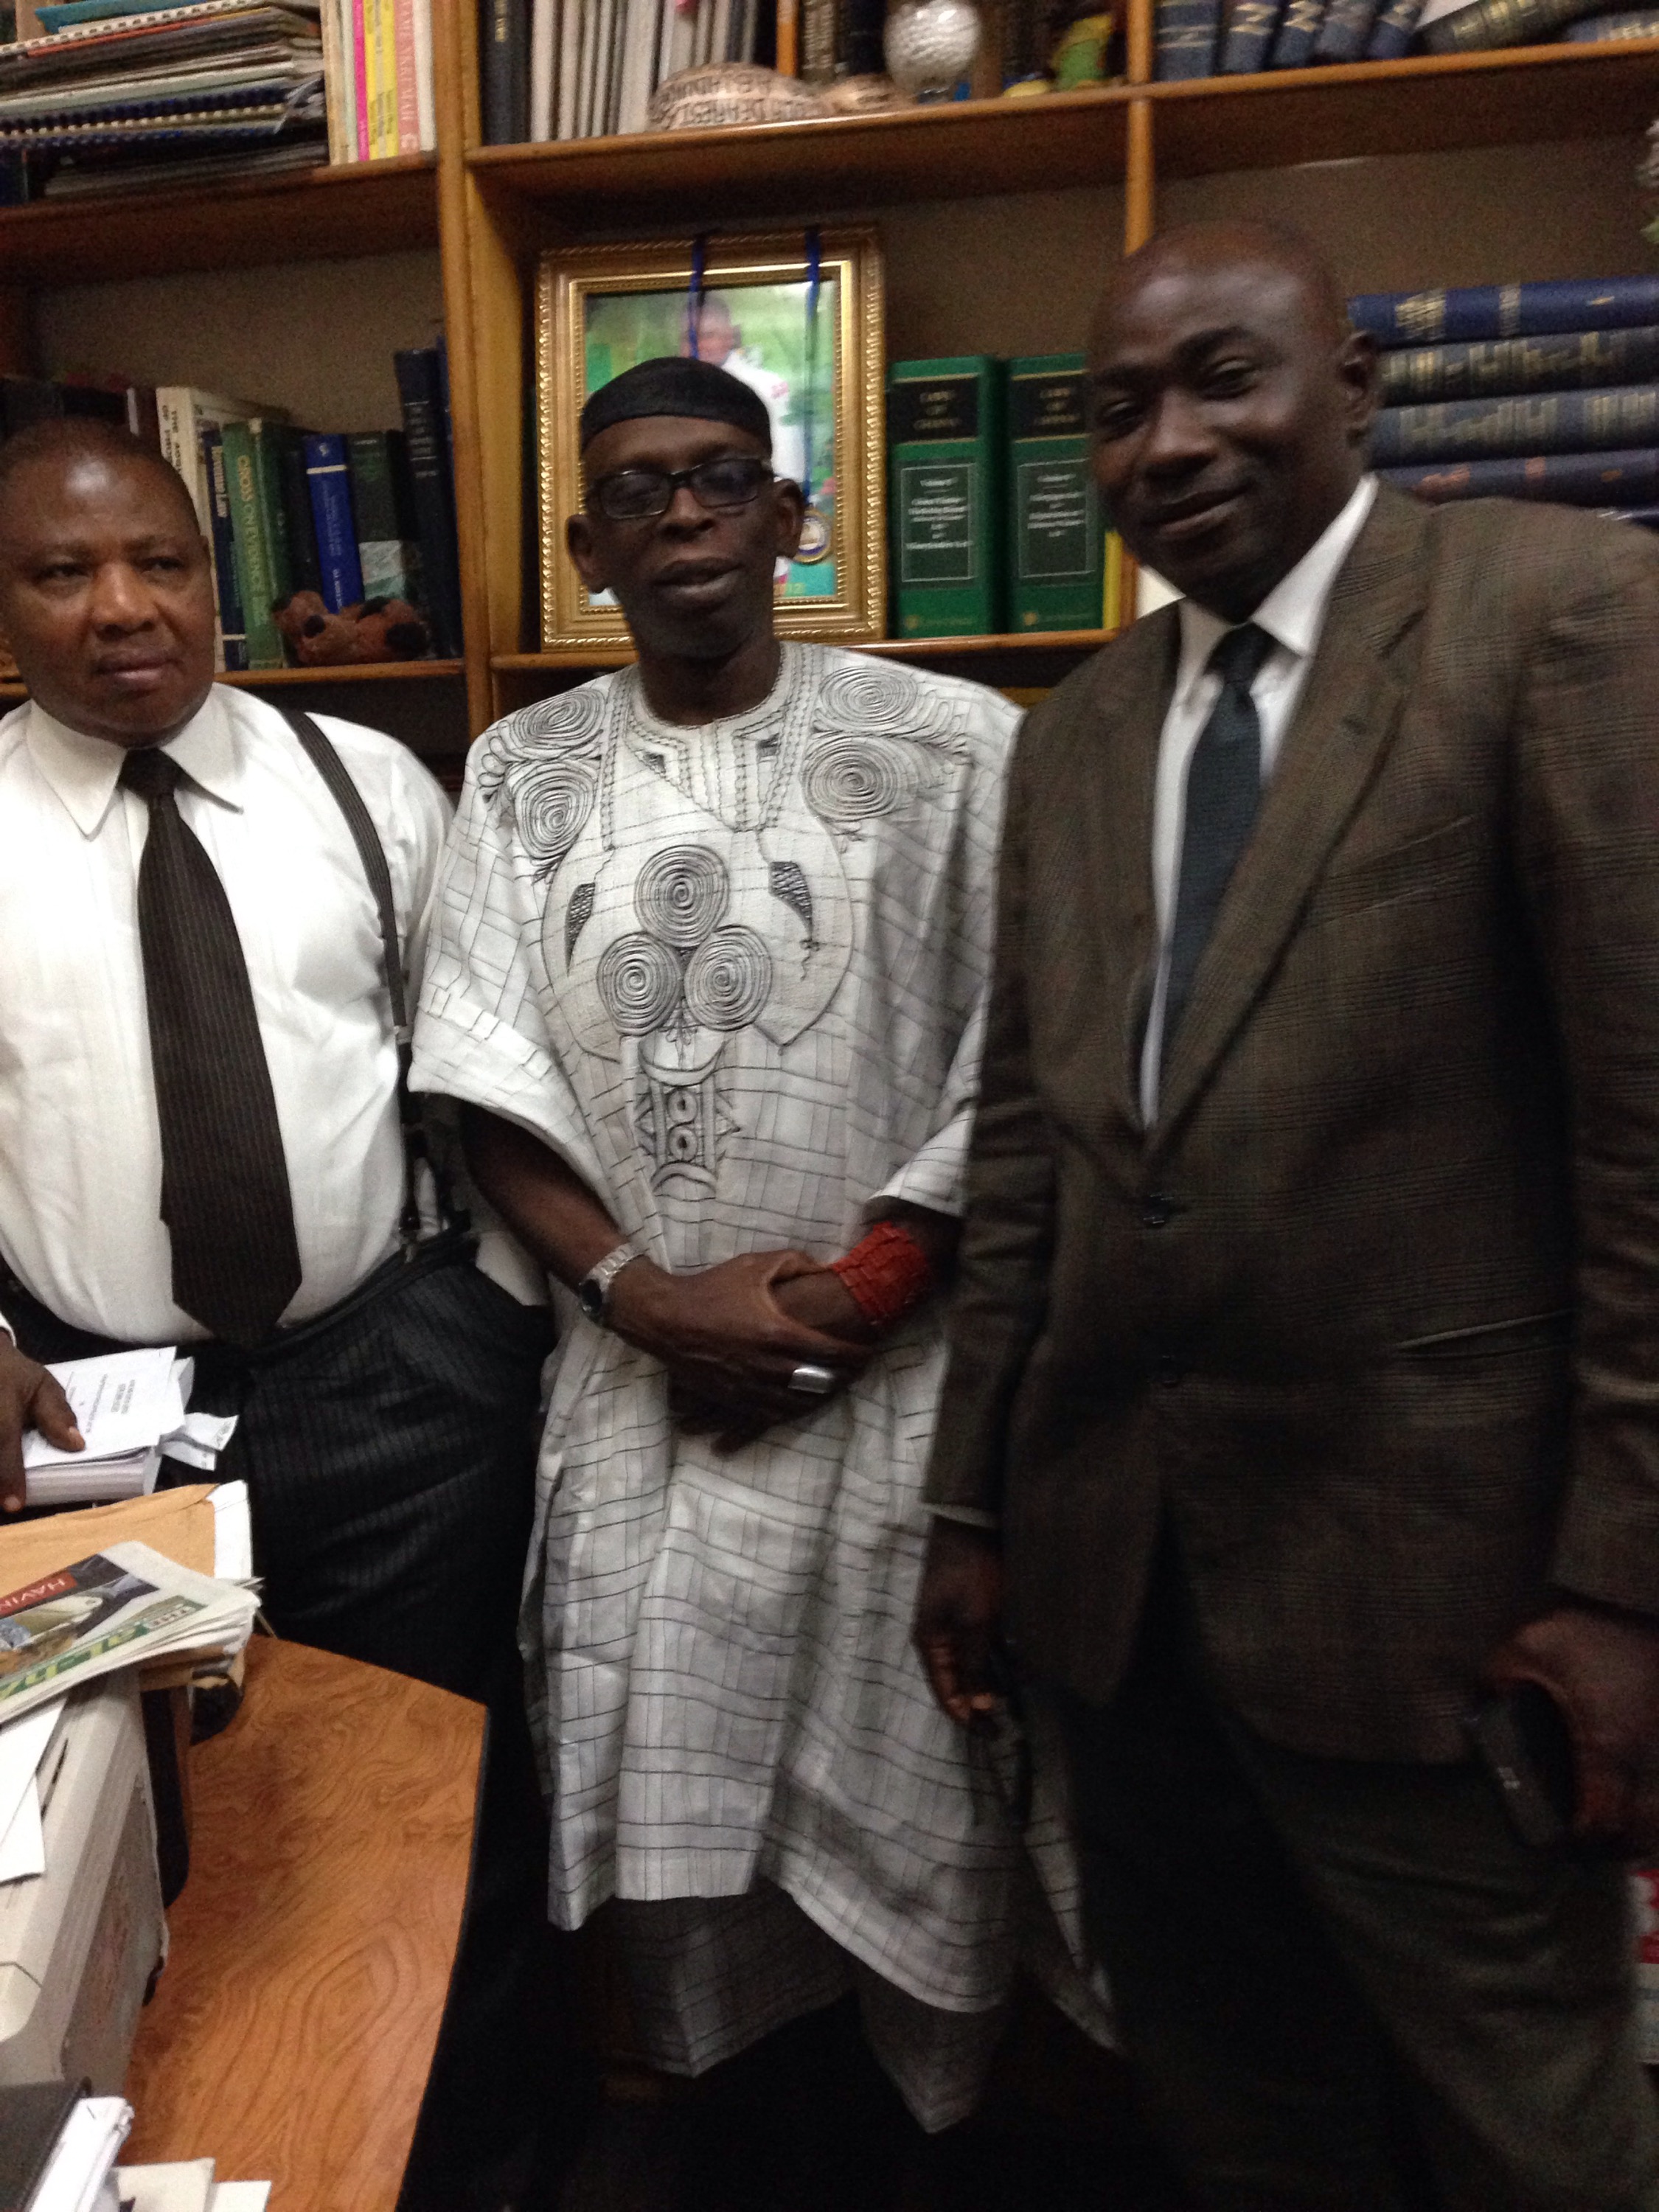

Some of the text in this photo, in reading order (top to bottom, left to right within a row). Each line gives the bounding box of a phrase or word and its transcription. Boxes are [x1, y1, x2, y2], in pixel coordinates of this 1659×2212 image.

[237, 454, 254, 501] CROSS
[216, 494, 228, 518] Law
[242, 504, 257, 526] ON
[245, 526, 265, 592] EVIDENCE
